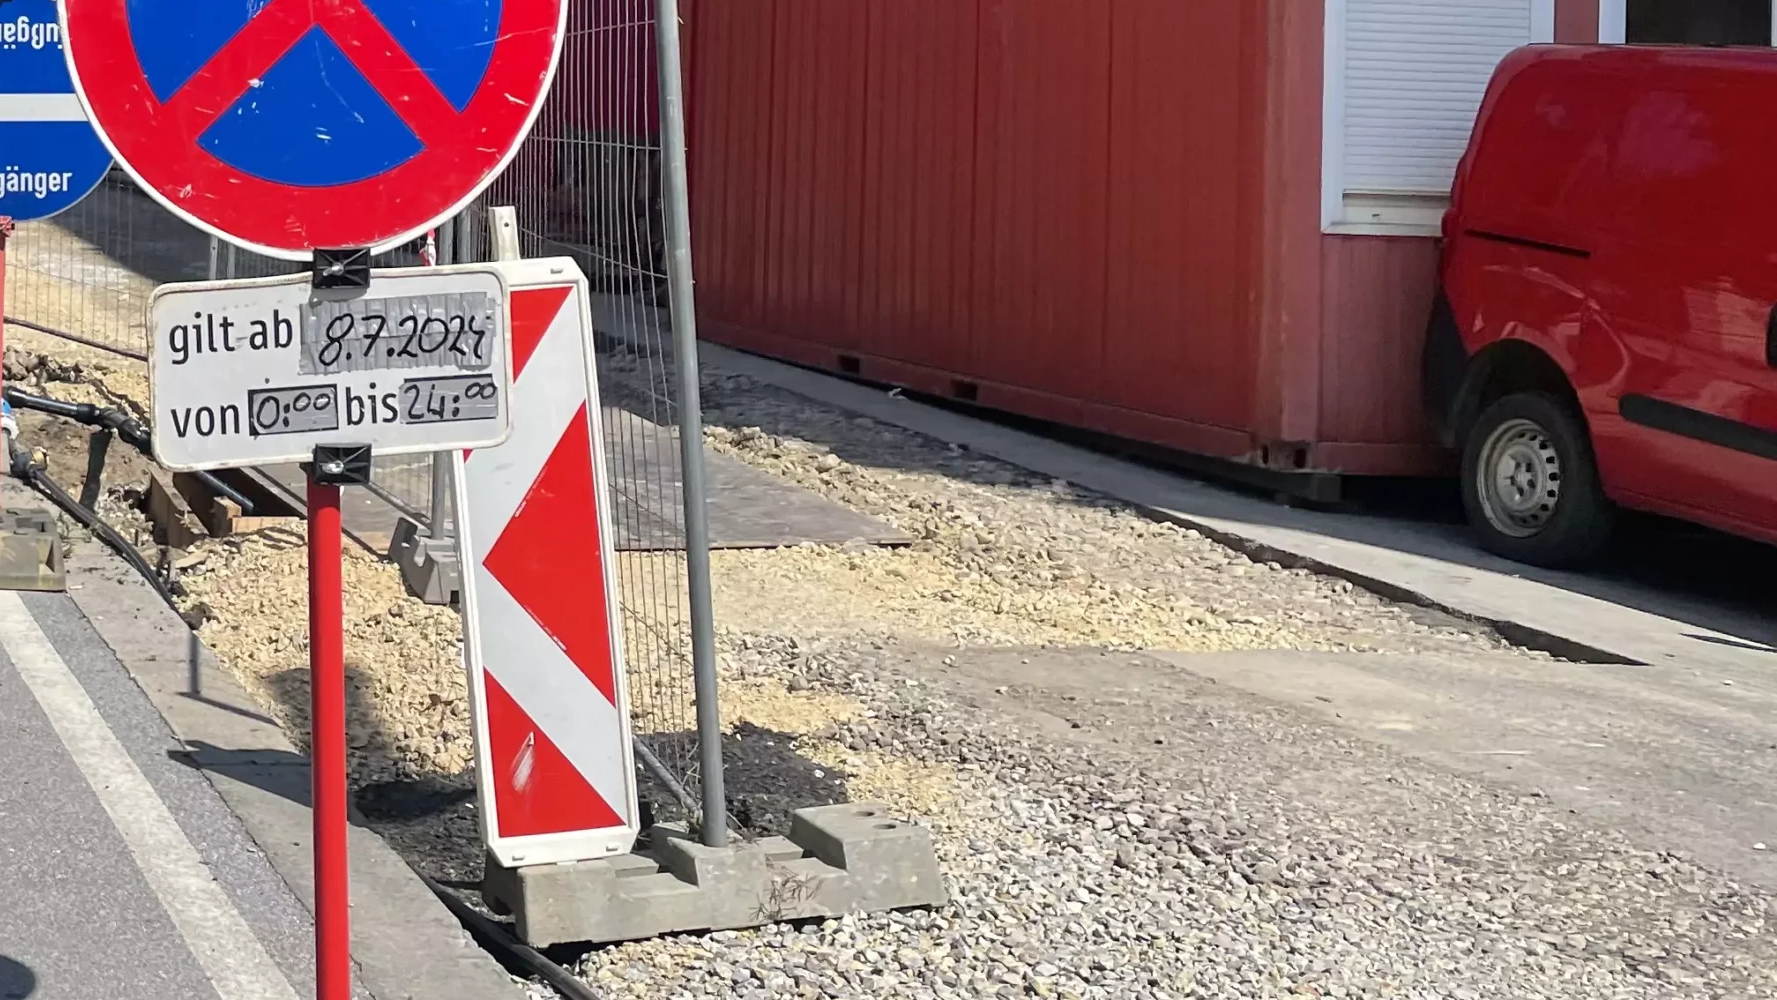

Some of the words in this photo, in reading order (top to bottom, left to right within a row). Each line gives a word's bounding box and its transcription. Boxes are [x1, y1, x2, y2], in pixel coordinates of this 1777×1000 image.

[169, 311, 235, 365] gilt
[248, 309, 294, 349] ab
[318, 312, 489, 367] 8.7.2024
[170, 403, 240, 438] von
[345, 382, 399, 426] bis
